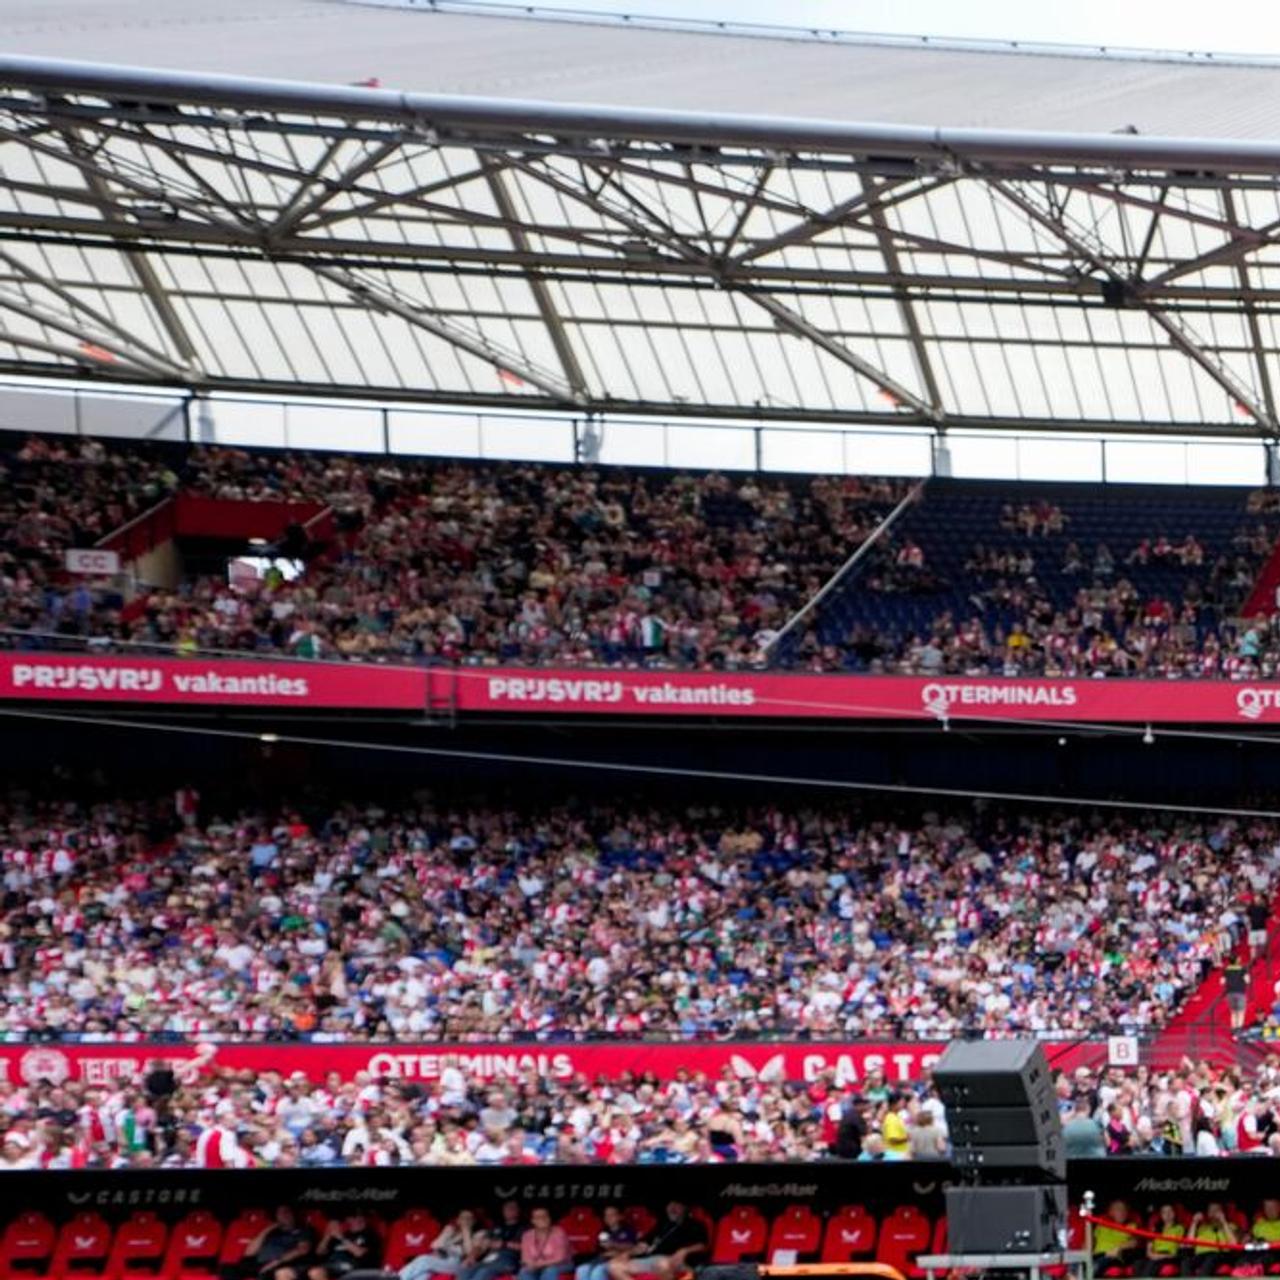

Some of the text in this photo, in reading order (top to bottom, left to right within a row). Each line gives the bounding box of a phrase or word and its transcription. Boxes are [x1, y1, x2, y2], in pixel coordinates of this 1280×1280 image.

[173, 670, 309, 697] vakanties
[633, 683, 754, 706] vakanties
[1115, 1040, 1131, 1061] B
